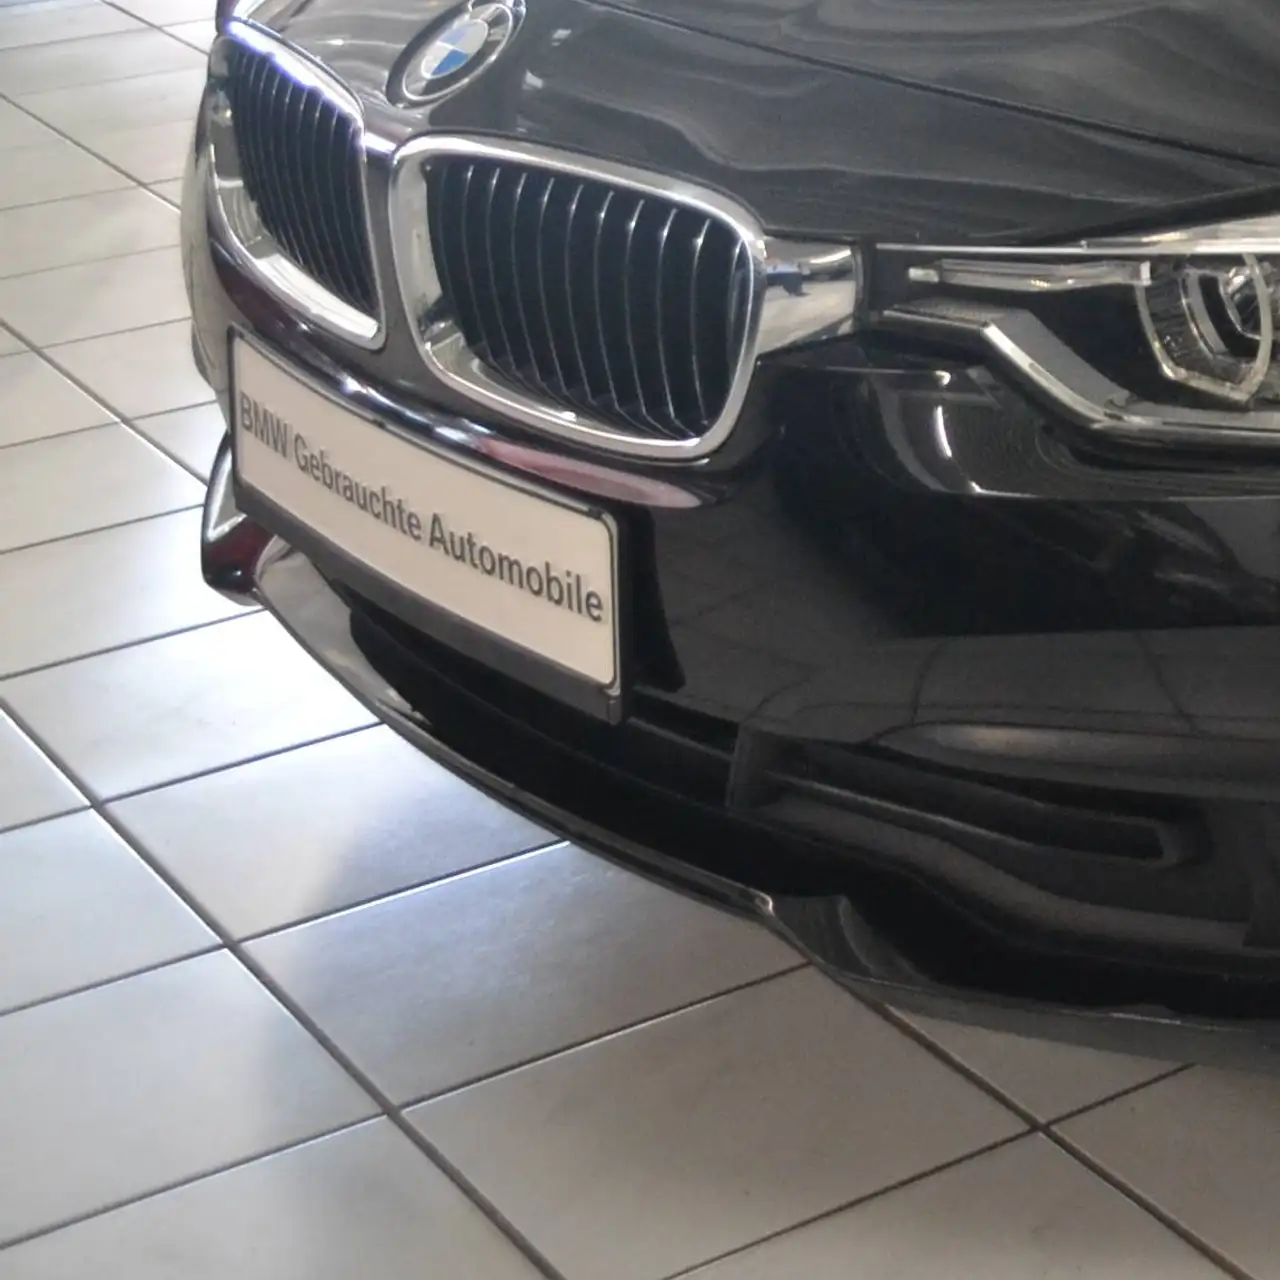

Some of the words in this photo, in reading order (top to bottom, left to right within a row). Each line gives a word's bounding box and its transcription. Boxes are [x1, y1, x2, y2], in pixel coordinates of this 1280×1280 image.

[240, 395, 289, 459] BMW
[294, 430, 422, 542] Gebrauchte
[428, 512, 603, 622] Automobile
